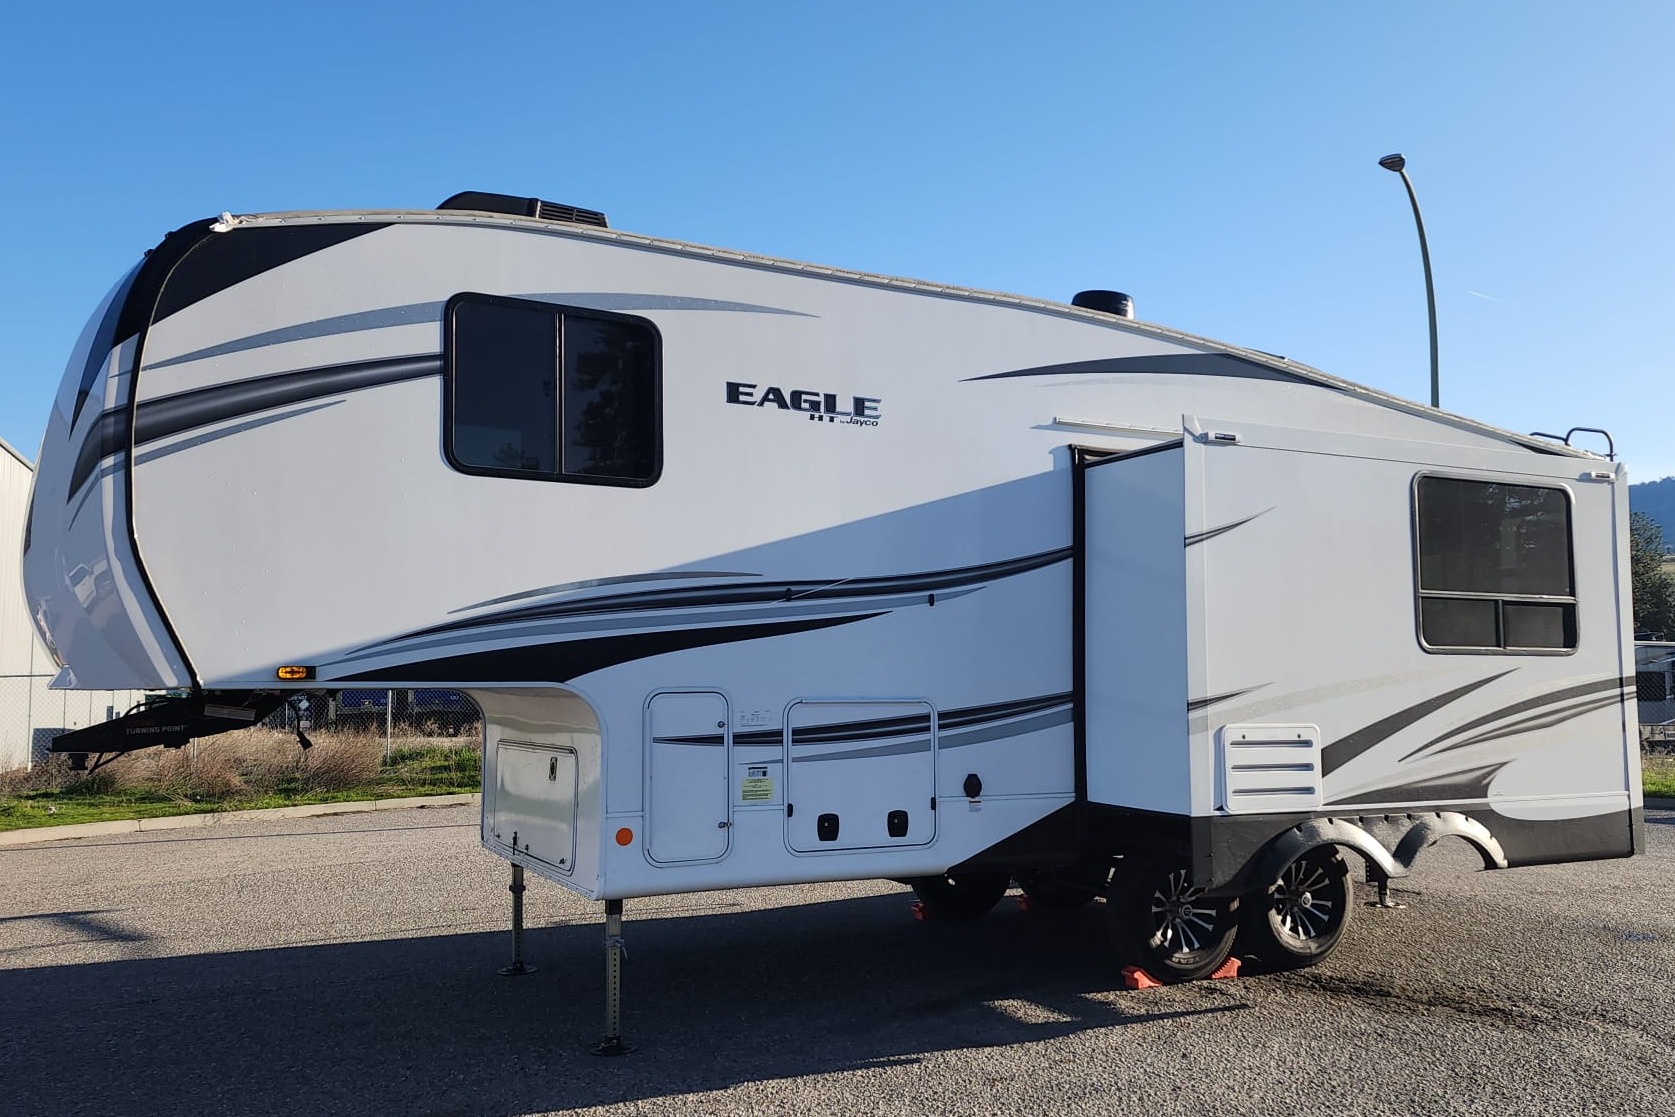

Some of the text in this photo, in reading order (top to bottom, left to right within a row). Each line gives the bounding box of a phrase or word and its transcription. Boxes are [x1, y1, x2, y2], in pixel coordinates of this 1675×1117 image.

[725, 381, 882, 420] EAGLE
[808, 413, 839, 423] HT
[846, 416, 879, 427] Jayco
[126, 724, 185, 735] TURNING POINT
